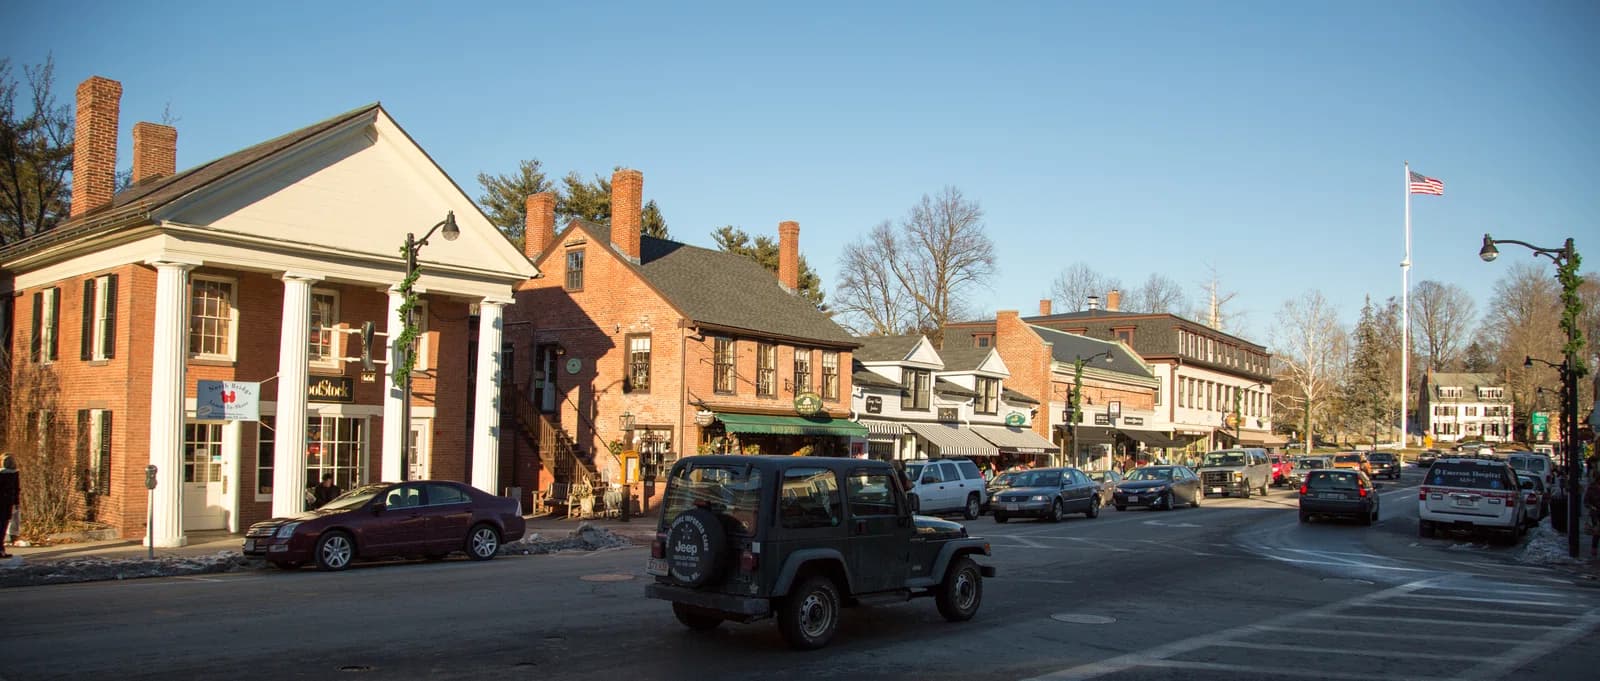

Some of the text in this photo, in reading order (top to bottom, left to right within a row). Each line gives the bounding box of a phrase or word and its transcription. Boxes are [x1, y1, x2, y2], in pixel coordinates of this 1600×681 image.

[208, 382, 252, 396] North Bridge
[308, 379, 349, 397] ootStock
[1442, 469, 1501, 479] Emerson Hospital
[674, 541, 698, 556] Jeep
